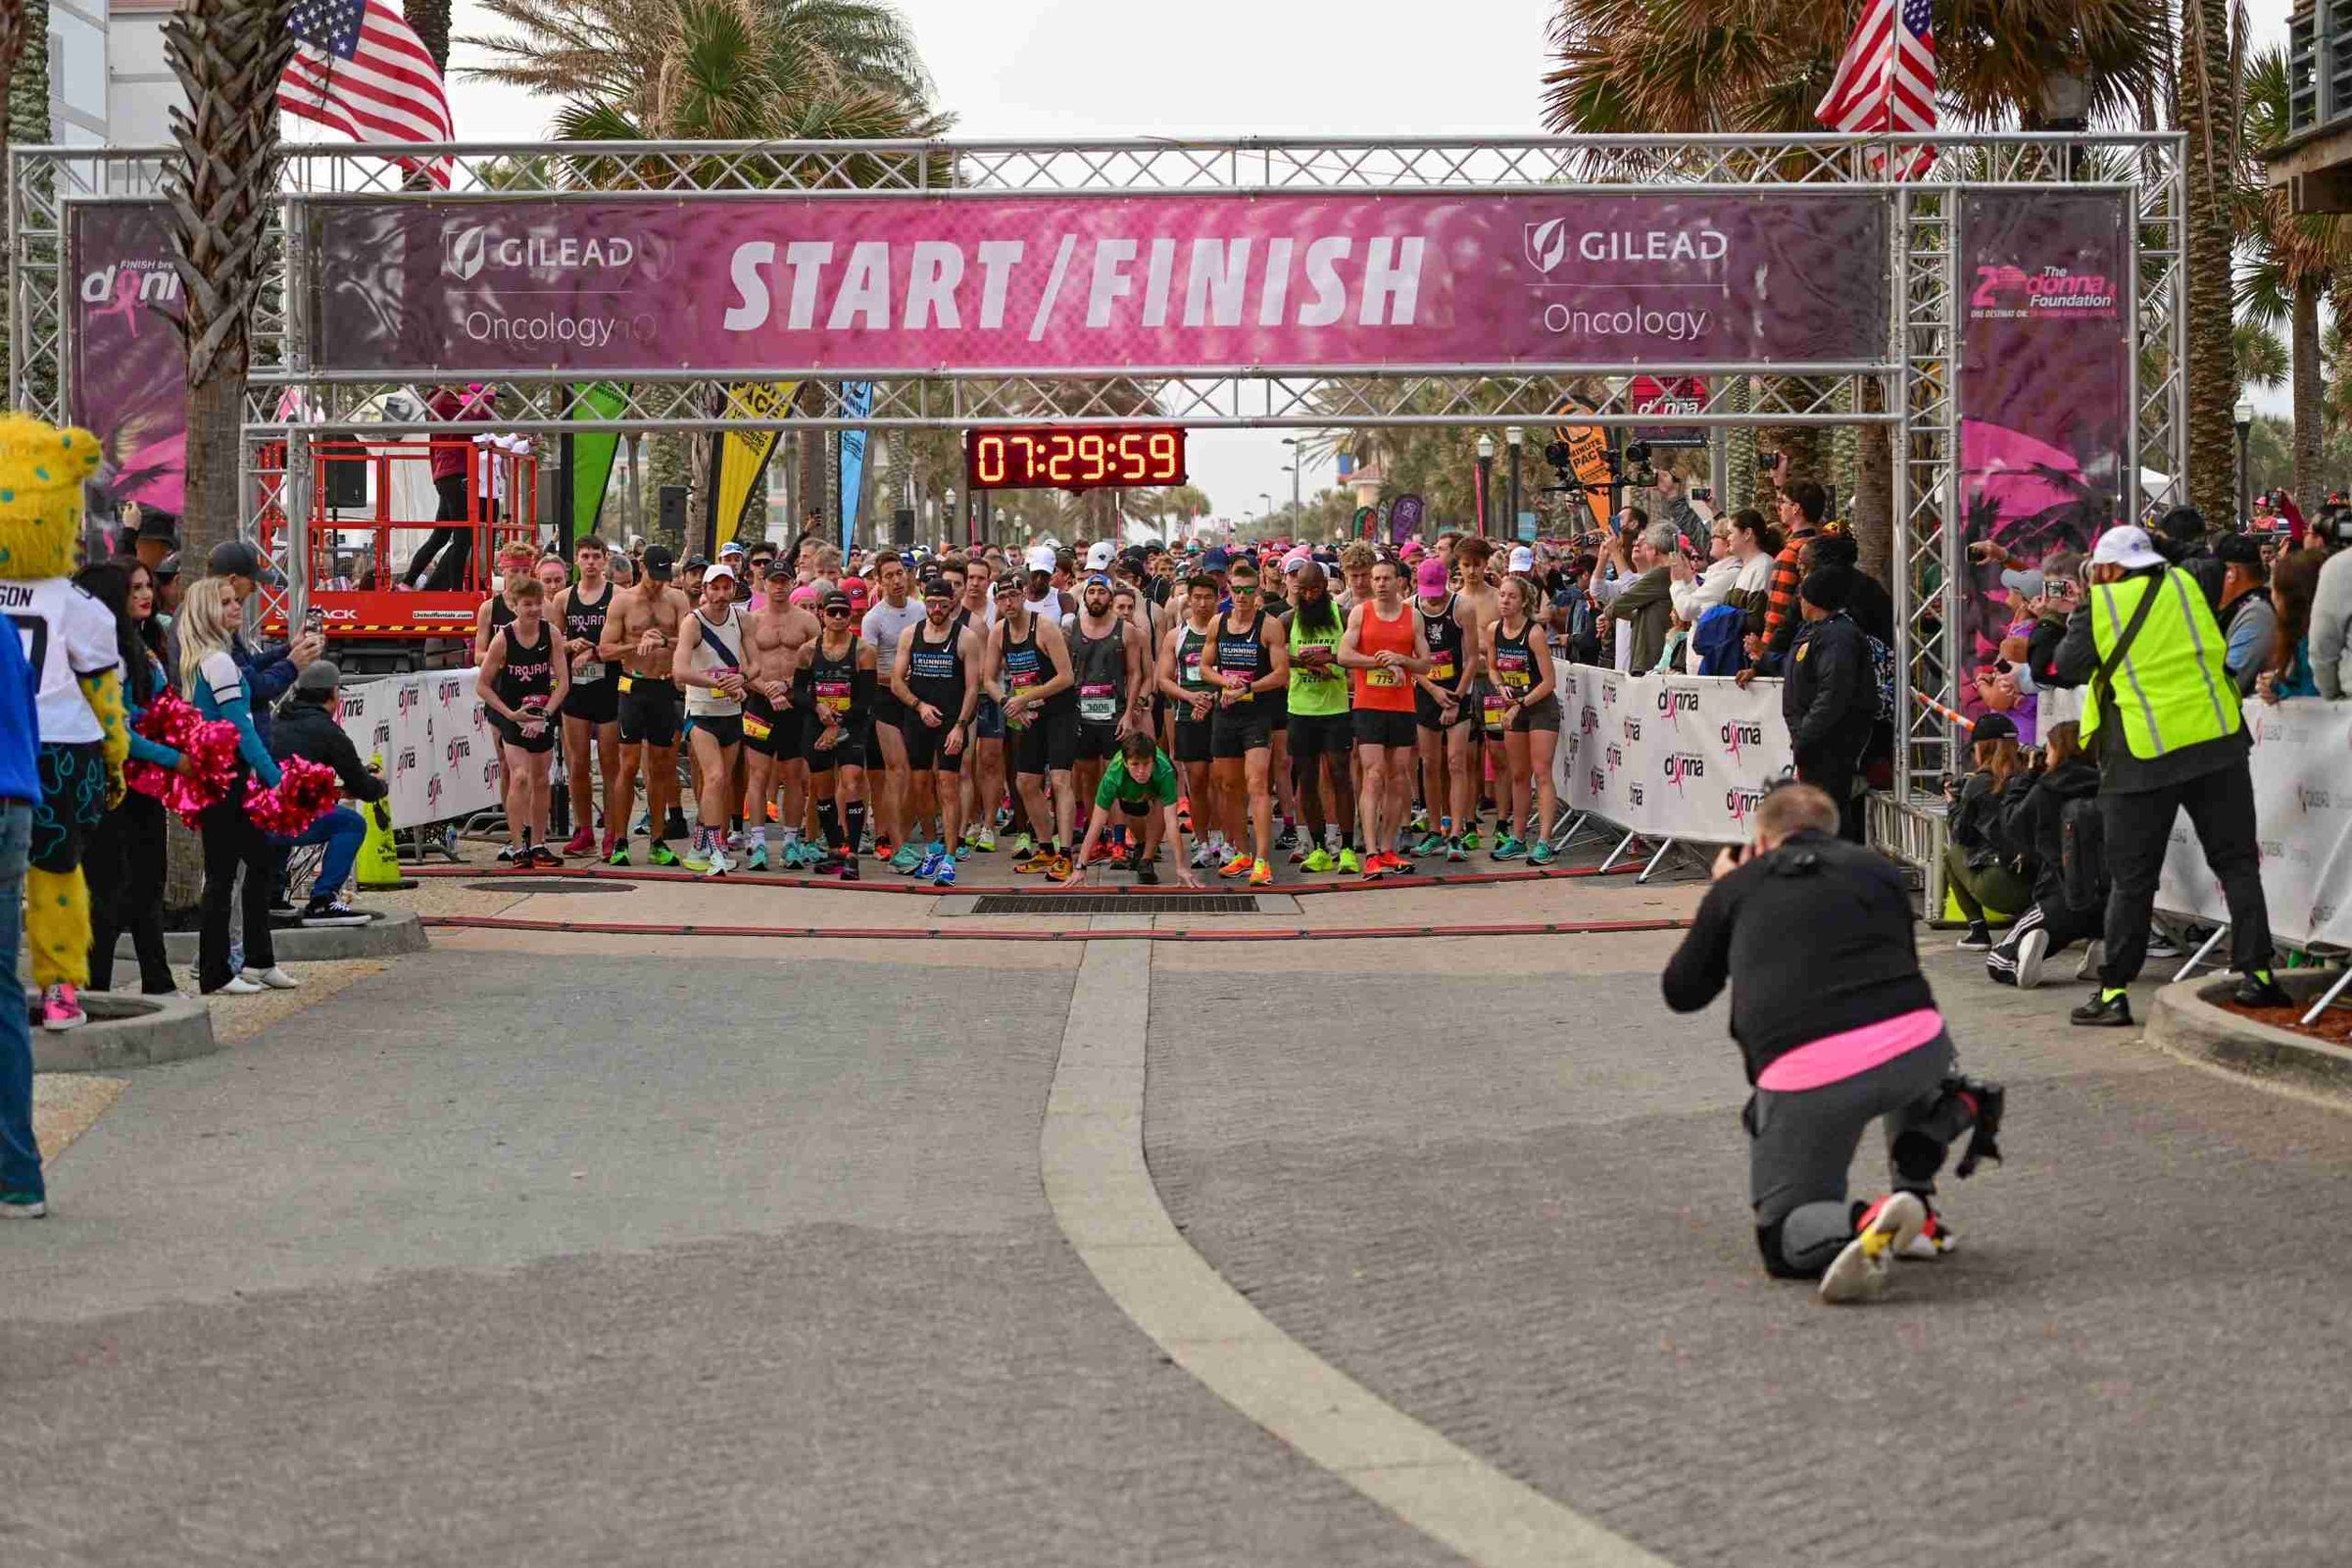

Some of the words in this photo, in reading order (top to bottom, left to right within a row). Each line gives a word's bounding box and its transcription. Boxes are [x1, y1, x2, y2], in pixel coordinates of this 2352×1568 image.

[499, 236, 634, 267] GILEAD
[1580, 230, 1729, 261] GILEAD
[121, 260, 156, 270] FINISH
[158, 260, 174, 270] bre
[2044, 266, 2068, 277] The
[81, 265, 180, 302] don
[723, 233, 1426, 342] START/FINISH
[2027, 273, 2106, 295] donna
[2030, 294, 2112, 308] Foundation
[465, 310, 615, 348] Oncology
[1544, 304, 1709, 341] Oncology
[978, 432, 1175, 481] 07:29:59
[336, 698, 365, 718] onna
[1657, 687, 1699, 712] donna
[1721, 722, 1762, 747] donna
[1664, 755, 1704, 778] donna
[1726, 789, 1765, 813] donn
